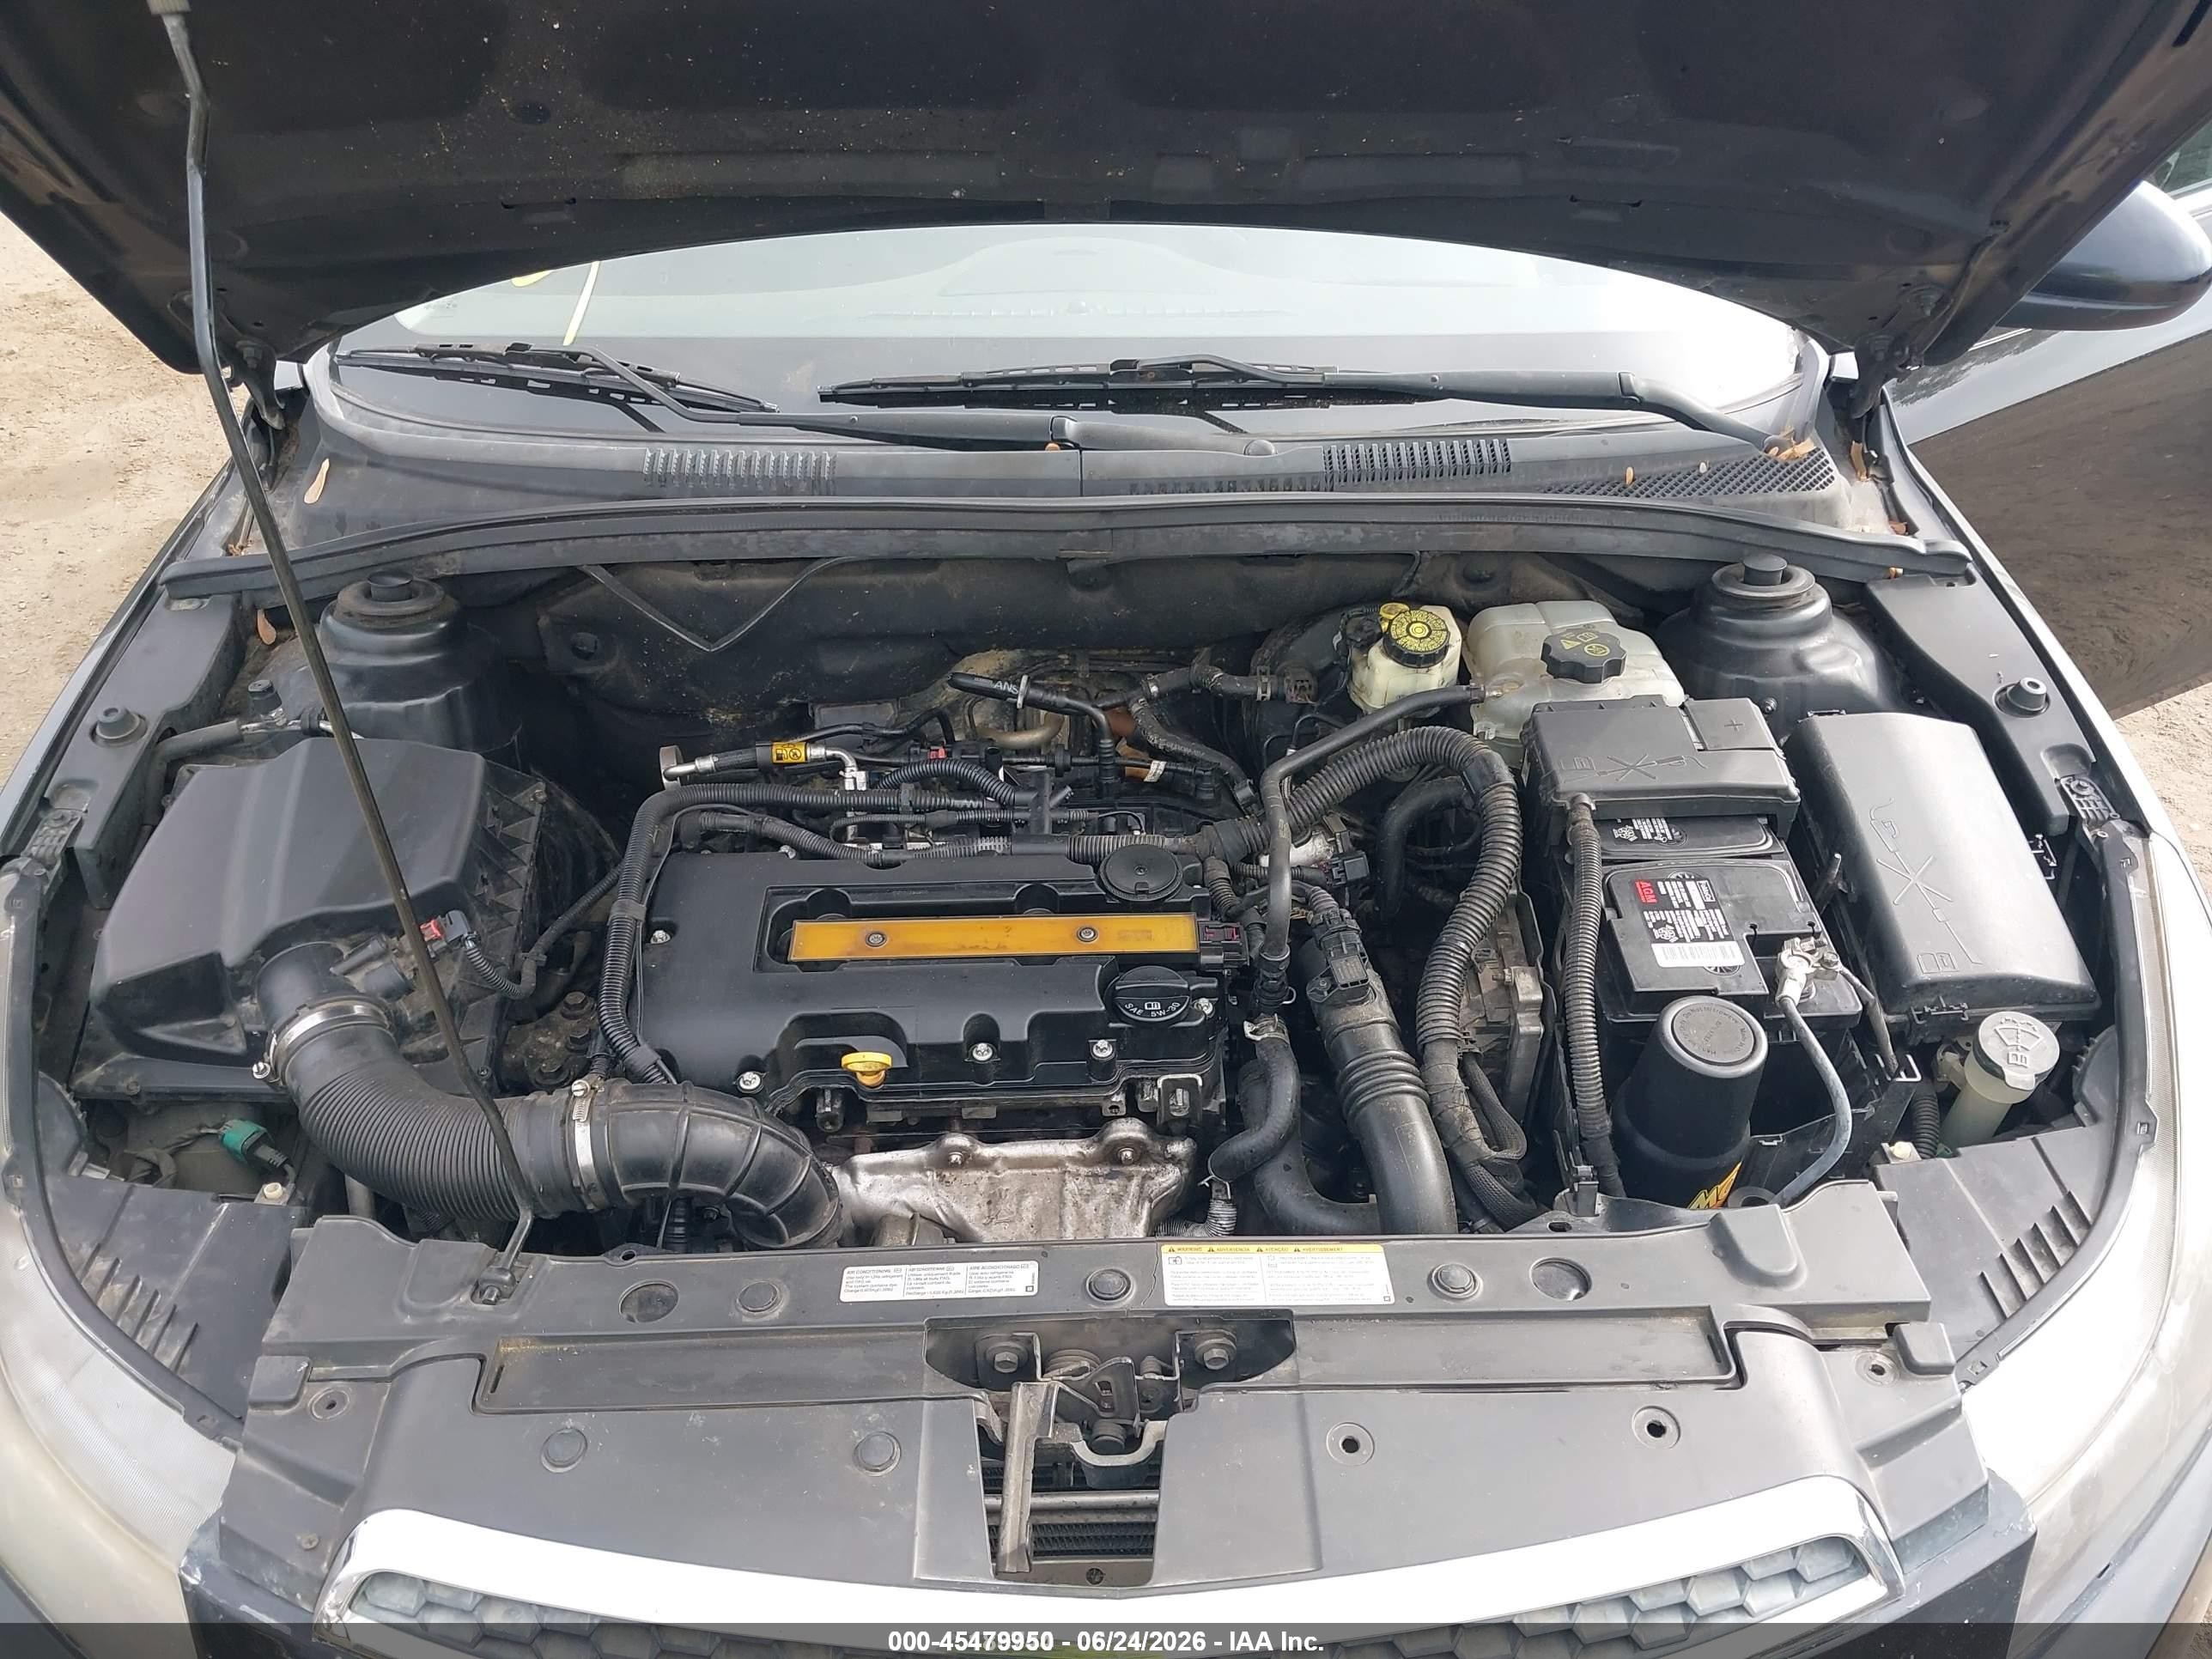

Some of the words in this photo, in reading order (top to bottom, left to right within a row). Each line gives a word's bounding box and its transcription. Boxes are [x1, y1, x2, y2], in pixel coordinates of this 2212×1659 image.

[1639, 880, 1658, 903] AGM
[1124, 1003, 1144, 1015] SAE
[1151, 1002, 1181, 1017] 5W-30
